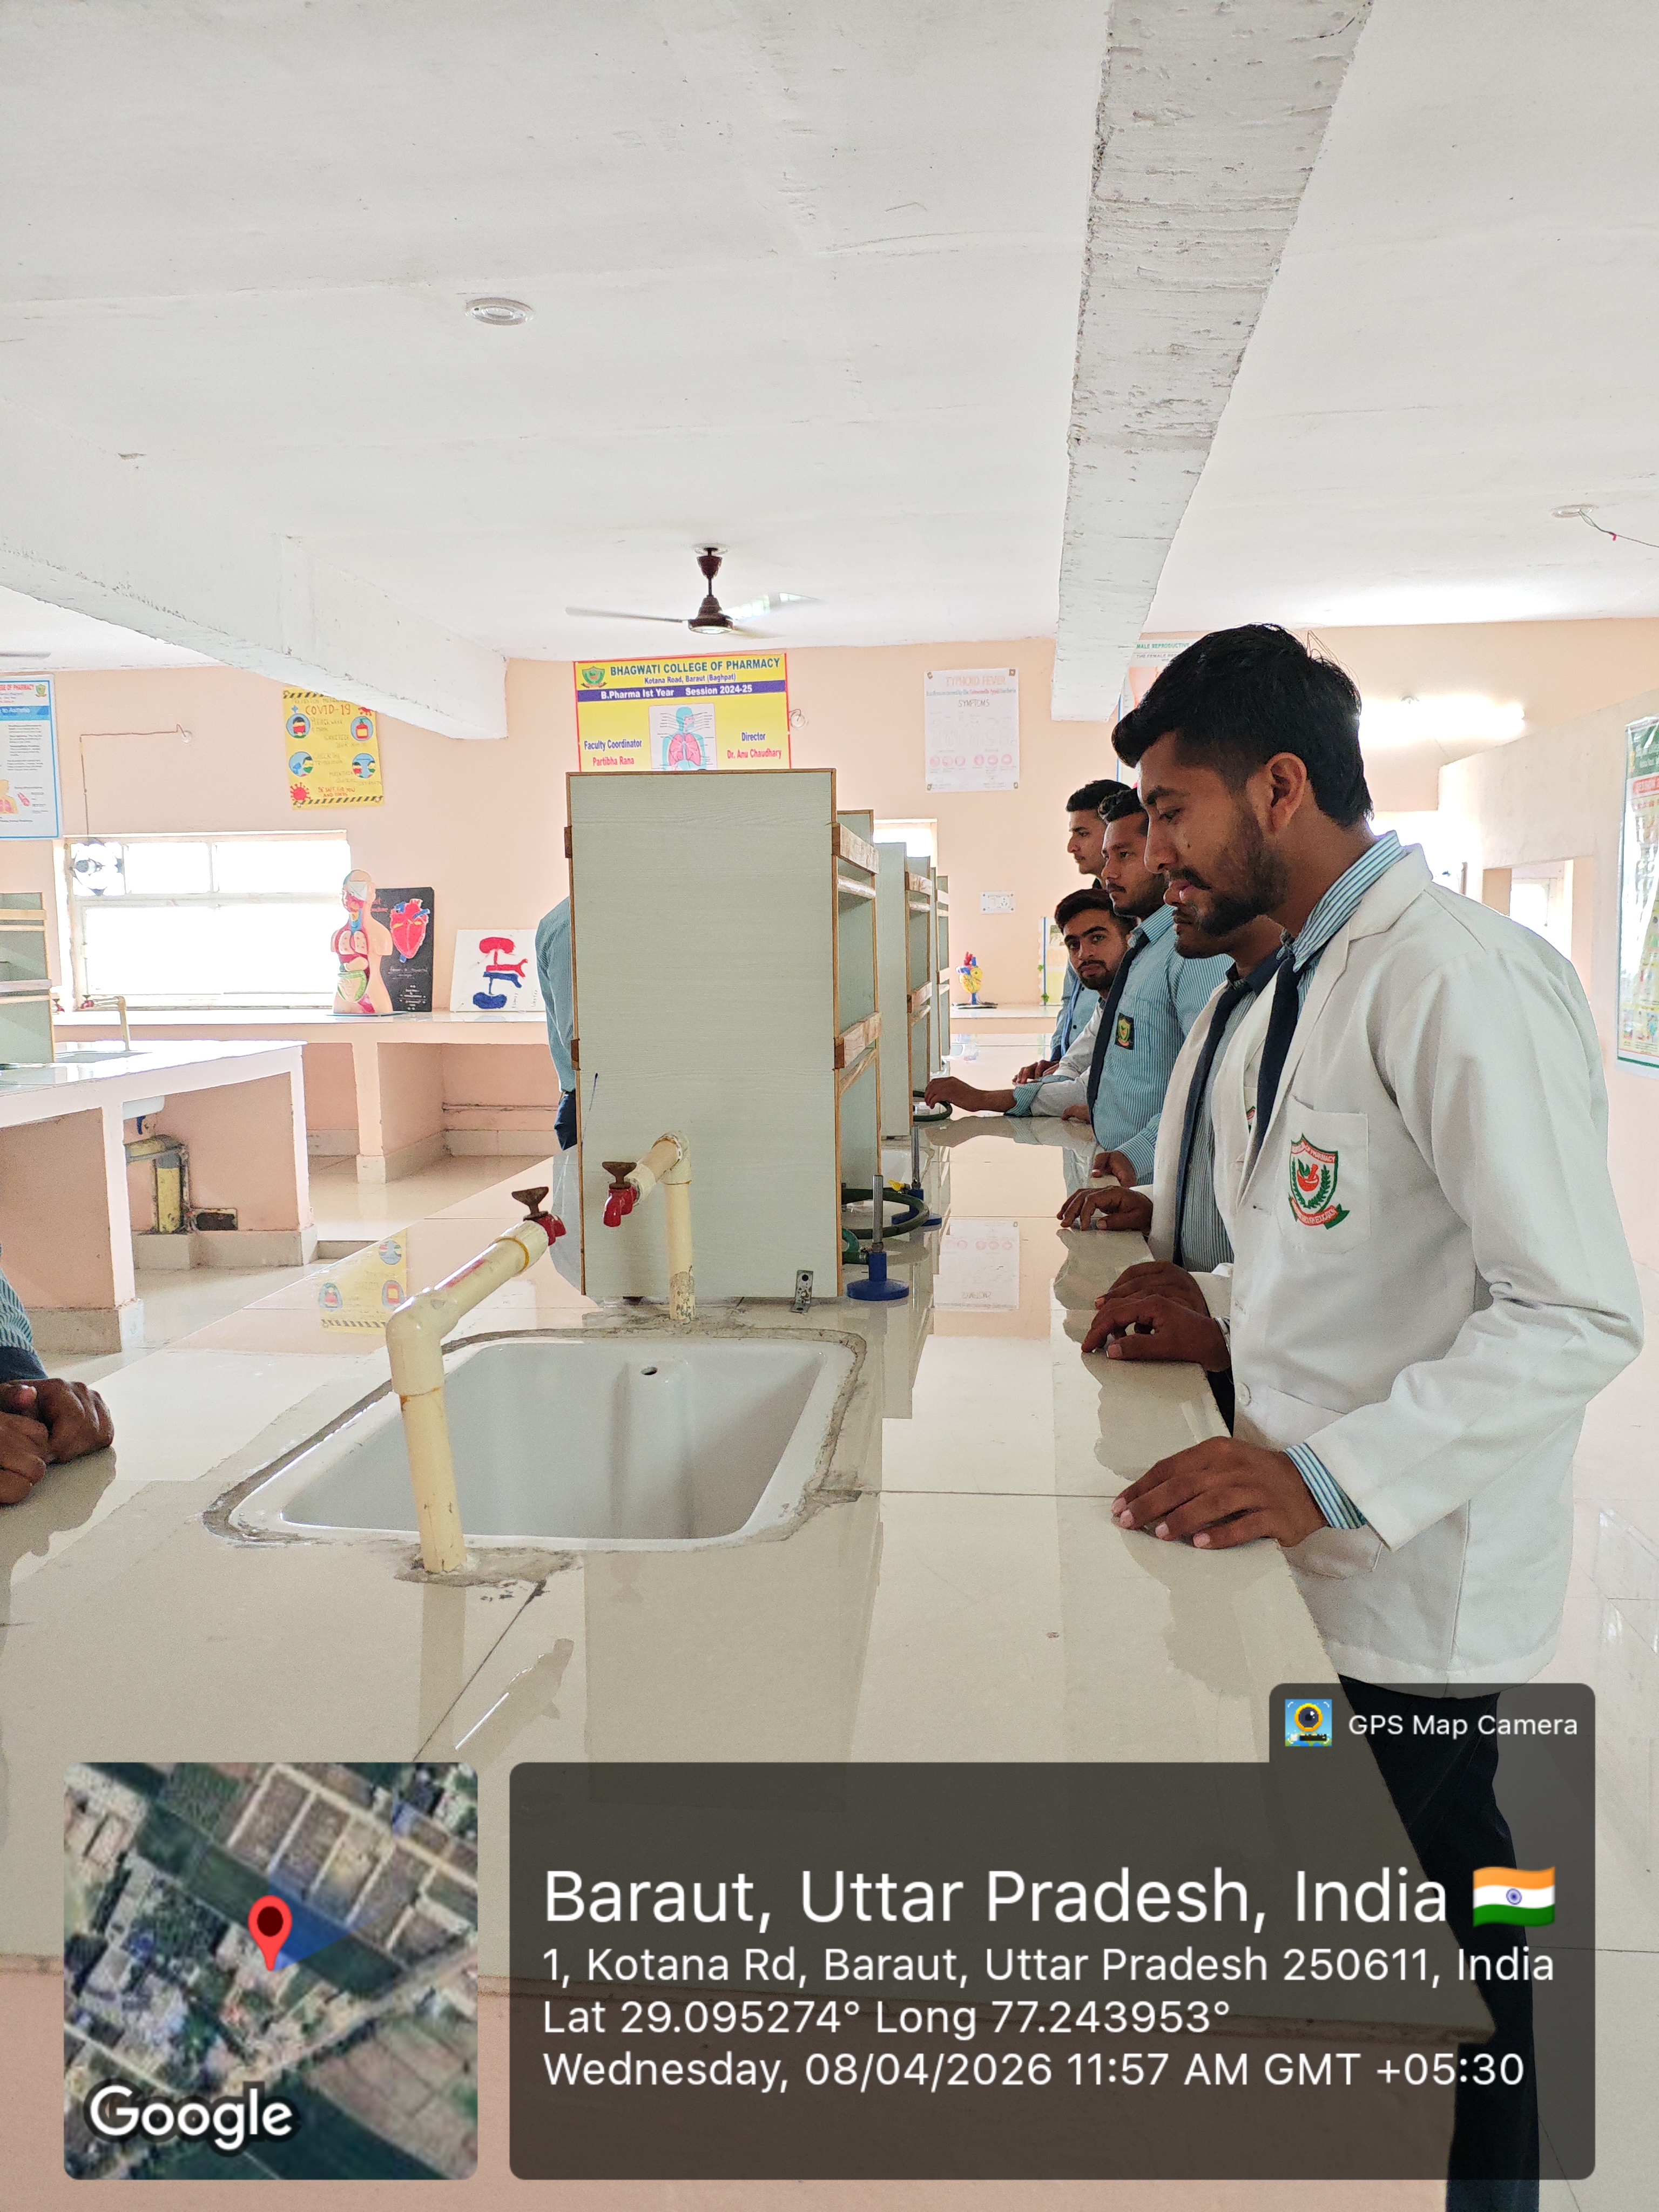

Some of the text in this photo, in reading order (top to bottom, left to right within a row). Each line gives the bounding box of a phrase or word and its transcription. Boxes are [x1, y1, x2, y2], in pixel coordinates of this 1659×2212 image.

[611, 658, 780, 676] BHAGWATI COLLEGE OF PHARMACY
[667, 676, 684, 684] Road,
[685, 675, 705, 683] Baraut
[707, 673, 736, 683] (Baghpat)
[601, 690, 640, 700] B.Pharma
[655, 687, 675, 697] Year
[685, 686, 718, 696] Session
[720, 684, 753, 694] 2024-25
[305, 703, 351, 716] COVID-19
[741, 732, 766, 741] Director
[584, 739, 642, 752] Faculty Coordinator
[727, 750, 735, 759] Dr.
